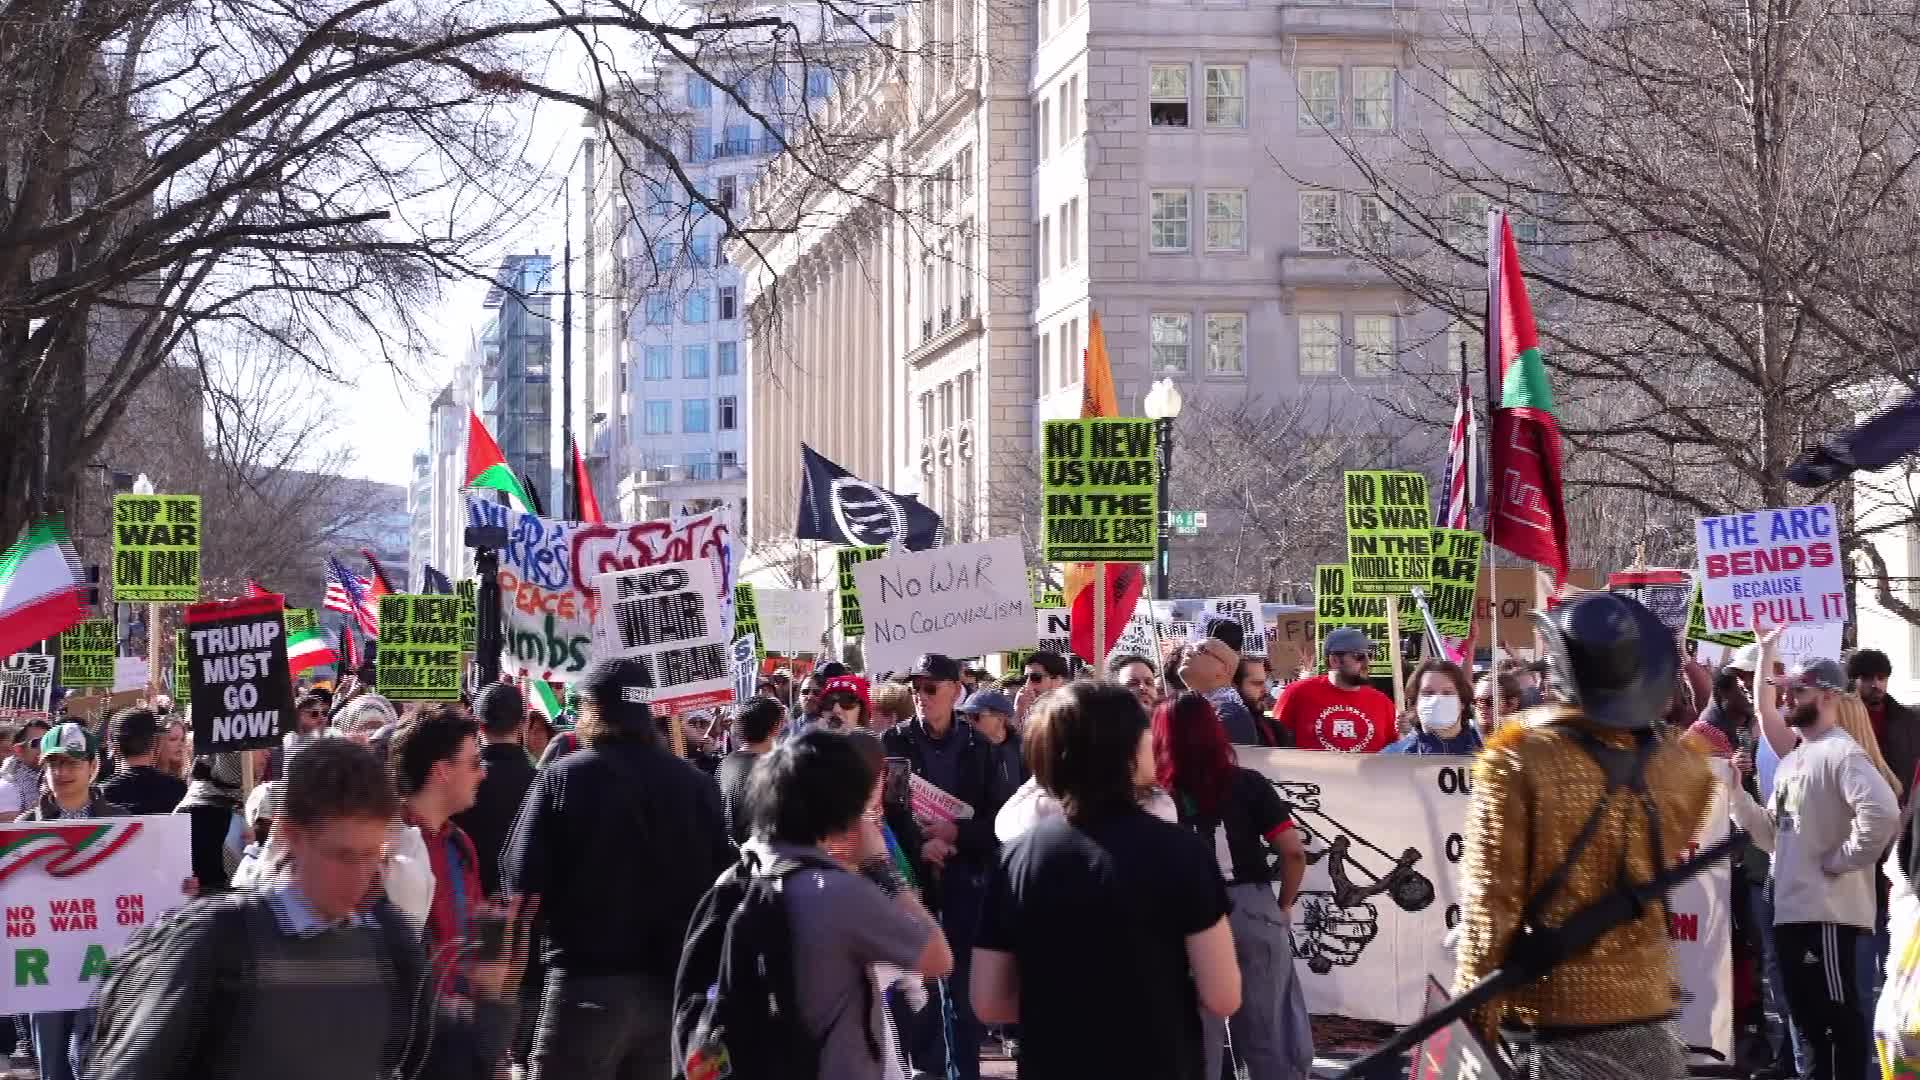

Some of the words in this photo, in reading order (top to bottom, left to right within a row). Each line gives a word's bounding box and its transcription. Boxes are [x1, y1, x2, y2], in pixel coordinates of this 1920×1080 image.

[1048, 422, 1084, 458] NO
[1090, 422, 1150, 458] NEW
[1048, 460, 1085, 486] US
[1088, 460, 1151, 486] WAR
[1350, 474, 1375, 506] NO
[1381, 474, 1425, 505] NEW
[116, 499, 161, 523] STOP
[165, 500, 196, 523] THE
[1048, 494, 1083, 516] IN
[1086, 494, 1150, 516] THE
[1350, 507, 1378, 529] US
[1380, 508, 1428, 528] WAR
[117, 525, 197, 545] WAR
[1048, 518, 1108, 544] MIDDLE
[1112, 518, 1151, 544] EAST
[1702, 514, 1759, 549] THE
[1769, 506, 1833, 542] ARC
[1351, 536, 1377, 556] IN
[1380, 535, 1430, 555] THE
[1449, 534, 1481, 560] THE
[116, 550, 143, 586] ON
[148, 550, 197, 586] IRAN!
[930, 553, 993, 594] WAR
[1351, 556, 1400, 579] MIDDLE
[1402, 556, 1430, 579] EAST
[1432, 559, 1475, 582] AR
[1705, 543, 1834, 579] BENDS
[616, 568, 690, 600] NO
[1319, 568, 1344, 596] NO
[1732, 576, 1802, 600] BECAUSE
[380, 597, 408, 624] NO
[413, 597, 457, 624] NEW
[1043, 594, 1065, 605] STO
[1215, 601, 1247, 615] NO
[1319, 597, 1345, 617] US
[1432, 584, 1474, 620] RAN!
[1707, 603, 1745, 630] WE
[1751, 596, 1814, 626] PULL
[1821, 592, 1845, 619] IT
[83, 621, 113, 638] NEW
[612, 591, 708, 649] WAR
[843, 609, 864, 626] MID
[909, 599, 1023, 635] COLONIALISM
[1048, 617, 1071, 634] N
[63, 639, 80, 651] US
[82, 639, 113, 651] WAR
[190, 621, 280, 655] TRUMP
[380, 626, 408, 645] US
[411, 626, 457, 645] WAR
[1039, 638, 1070, 653] BOM
[63, 654, 80, 666] IN
[82, 654, 113, 666] THE
[202, 651, 273, 684] MUST
[380, 650, 405, 666] IN
[407, 650, 457, 666] THE
[656, 643, 731, 688] IRAN
[0, 673, 31, 686] HANDS
[33, 676, 51, 688] OFF
[380, 668, 425, 688] MIDDLE
[427, 668, 457, 688] EAST
[0, 685, 47, 710] IRAN
[222, 684, 258, 711] GO
[211, 710, 280, 743] NOW!
[6, 905, 36, 922] NO
[50, 898, 95, 915] WAR
[115, 894, 144, 909] ON
[6, 921, 36, 938] NO
[49, 915, 97, 932] WAR
[116, 910, 144, 926] ON
